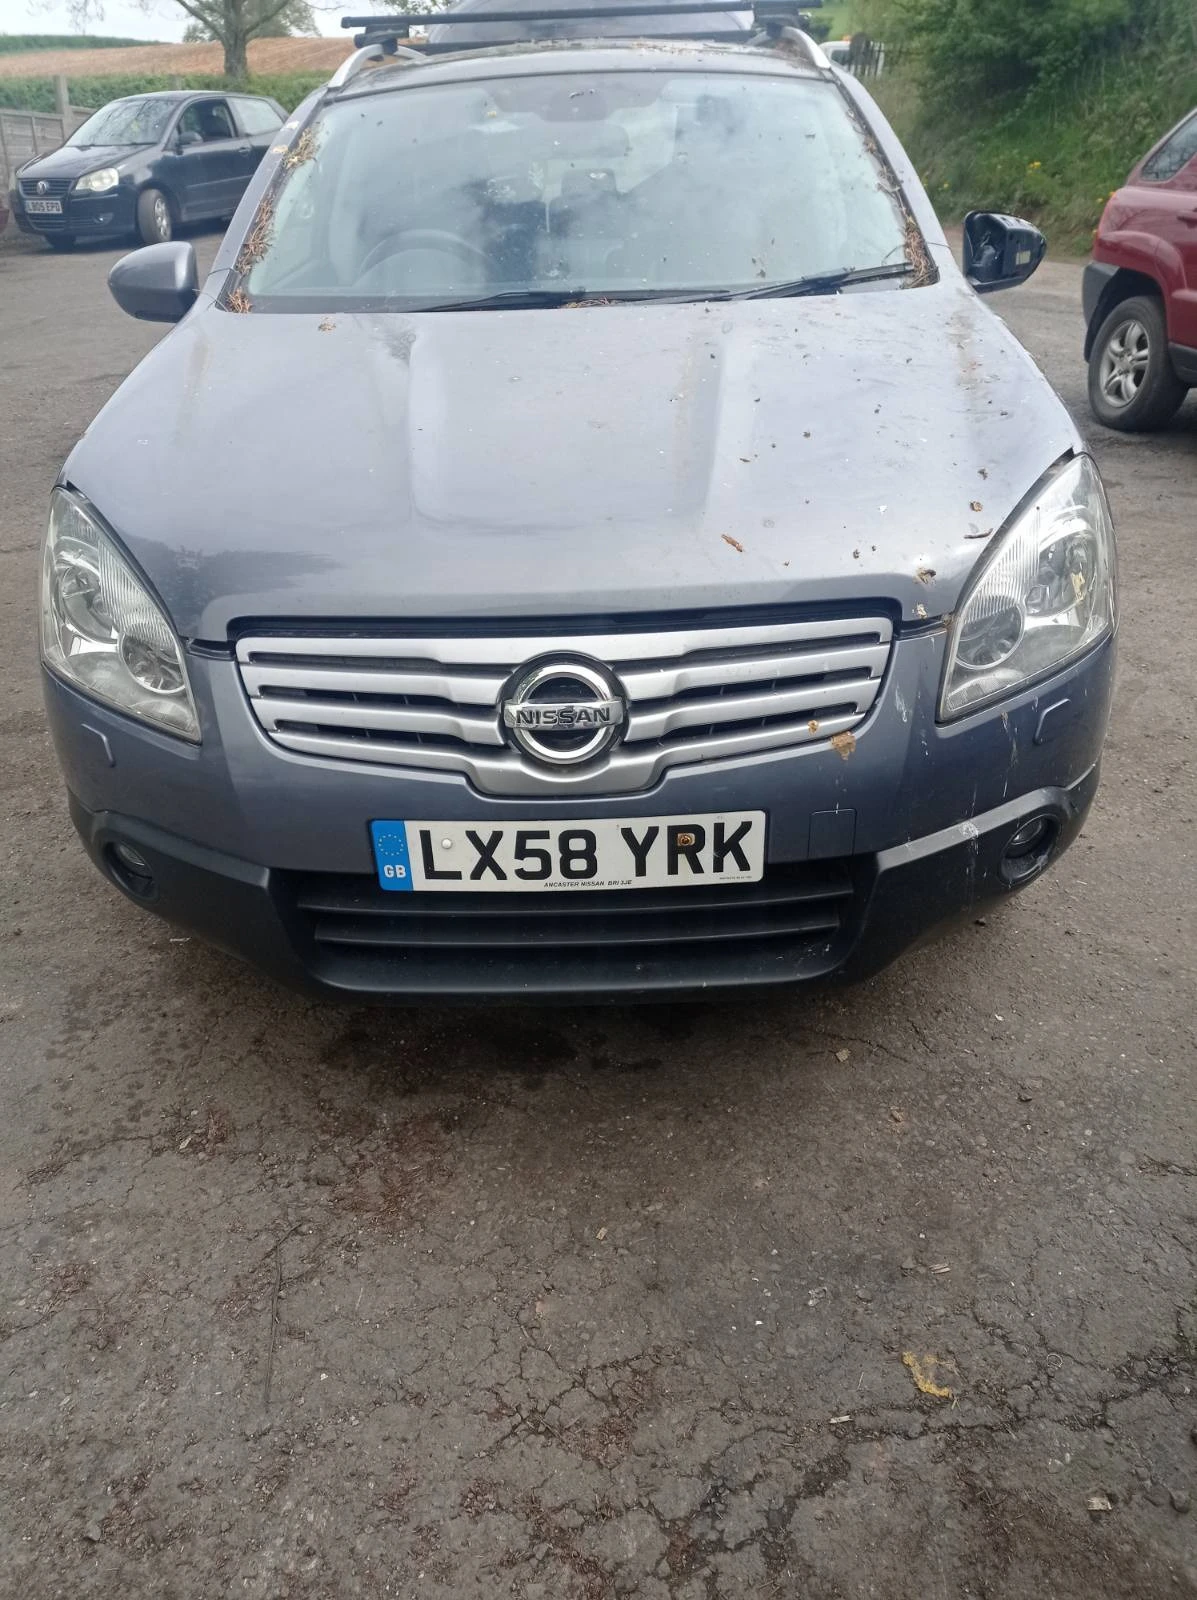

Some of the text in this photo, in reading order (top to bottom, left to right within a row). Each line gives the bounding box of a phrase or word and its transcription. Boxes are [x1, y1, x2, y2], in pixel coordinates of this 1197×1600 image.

[515, 707, 610, 724] NISSAN
[419, 820, 753, 881] LX58 YRK
[383, 864, 407, 878] GB
